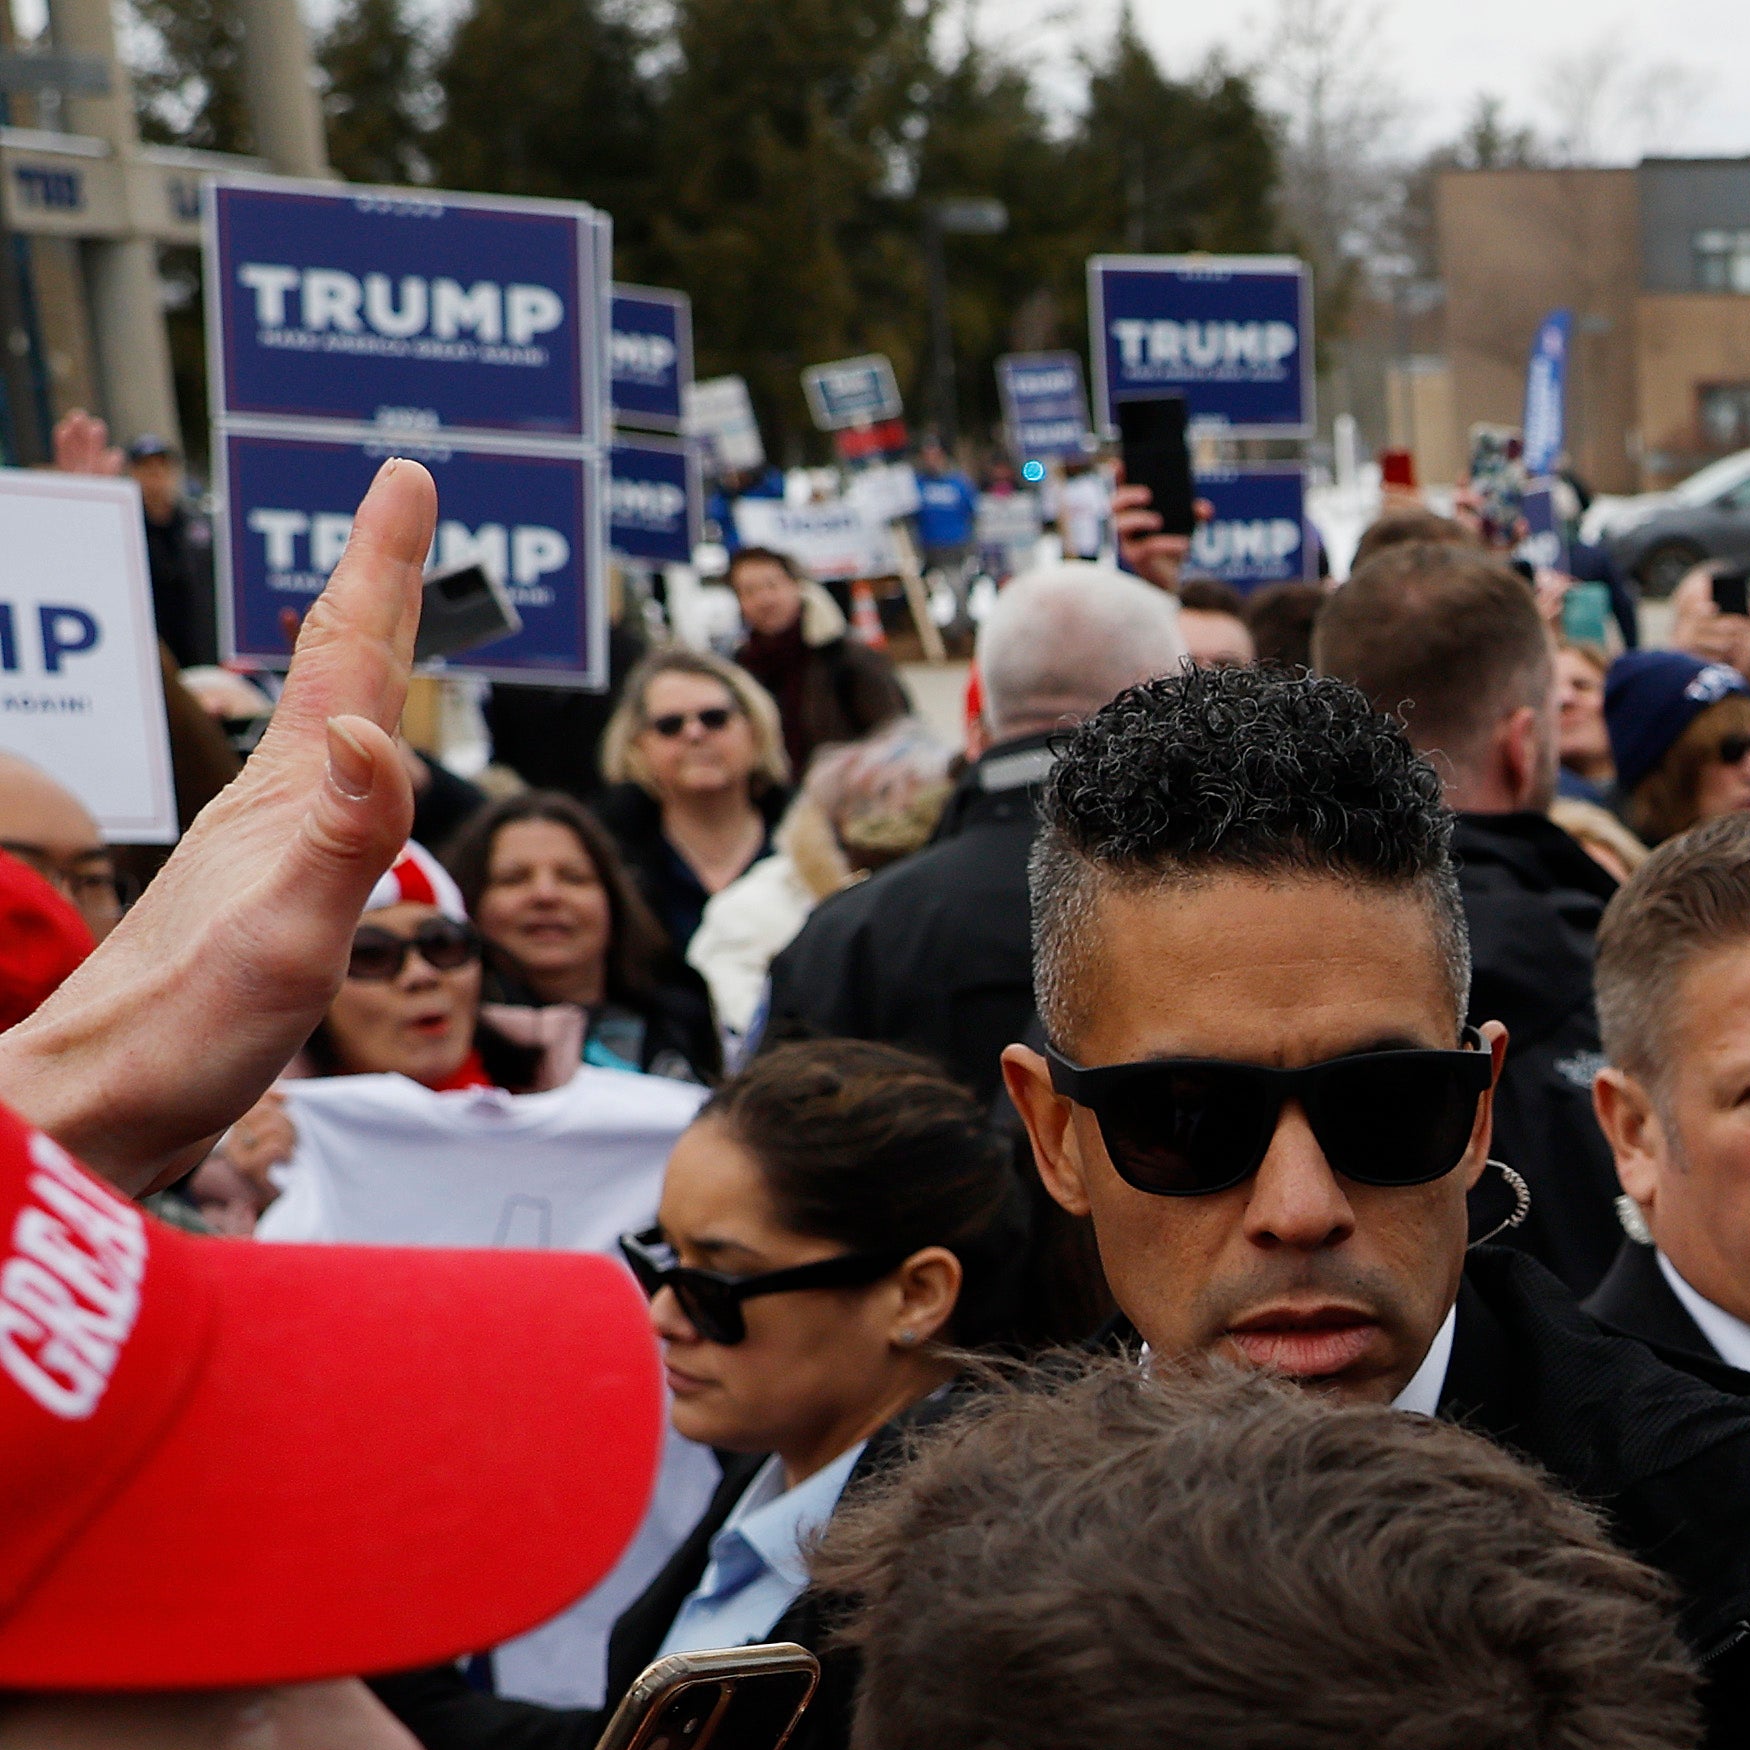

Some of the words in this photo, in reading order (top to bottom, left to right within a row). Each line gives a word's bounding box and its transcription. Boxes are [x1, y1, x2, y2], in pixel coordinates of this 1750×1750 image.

[238, 262, 564, 348] TRUMP
[1110, 317, 1299, 367] TRUMP
[248, 506, 571, 584] TRMP
[1192, 518, 1300, 568] UMP
